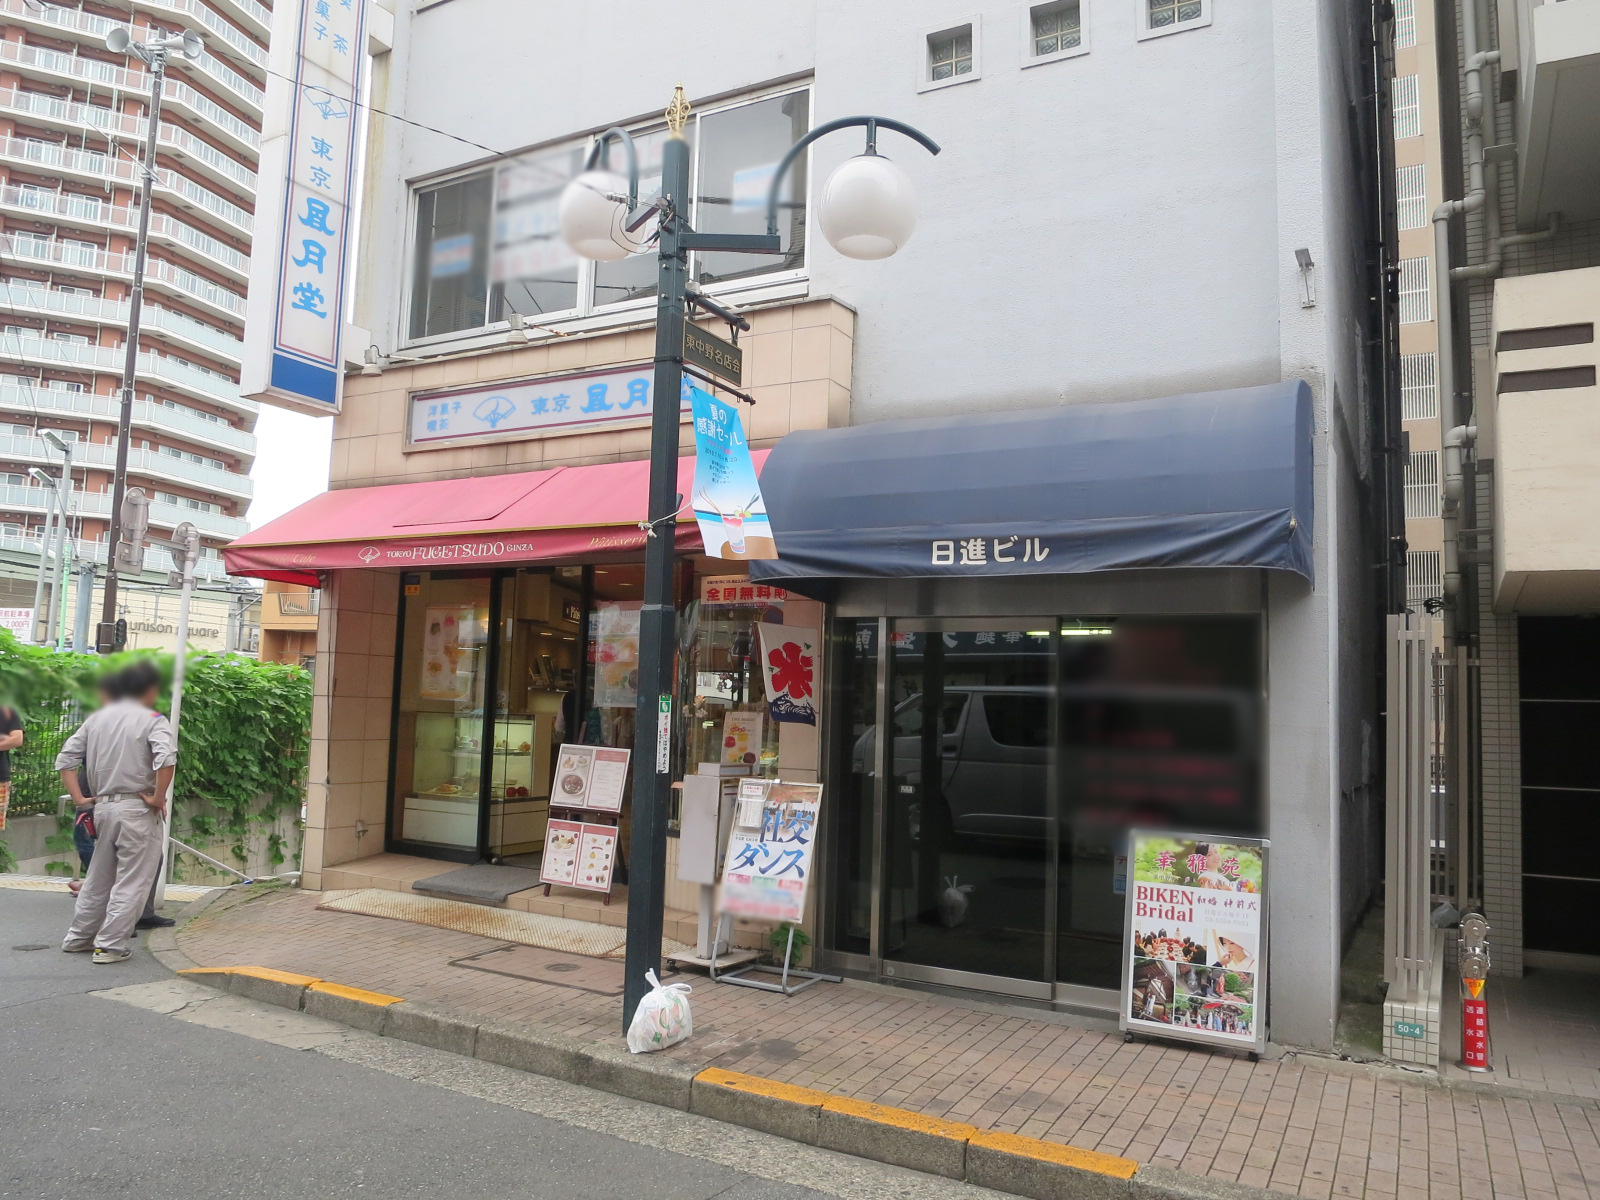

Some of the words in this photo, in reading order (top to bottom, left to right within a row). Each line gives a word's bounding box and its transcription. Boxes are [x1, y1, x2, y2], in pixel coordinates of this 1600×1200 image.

[685, 333, 740, 373] 東中野名店会
[427, 401, 462, 418] 洋菓子
[709, 403, 728, 425] 夏の
[426, 419, 449, 432] 喫茶
[697, 416, 743, 447] 感謝セール
[386, 549, 411, 558] TOKYO
[411, 541, 504, 560] FUGETSUDO
[506, 543, 534, 552] GINZA
[587, 533, 648, 548] Pâtisseri
[931, 535, 1050, 565] 日進ビル
[129, 618, 173, 634] unison
[760, 810, 813, 845] 社交
[729, 842, 804, 878] ダンス
[1154, 850, 1241, 878] 華雅苑
[1136, 885, 1194, 906] BIKEN
[1135, 901, 1193, 923] Bridal
[1397, 1024, 1420, 1035] 50-4
[1466, 1005, 1474, 1059] 送水口
